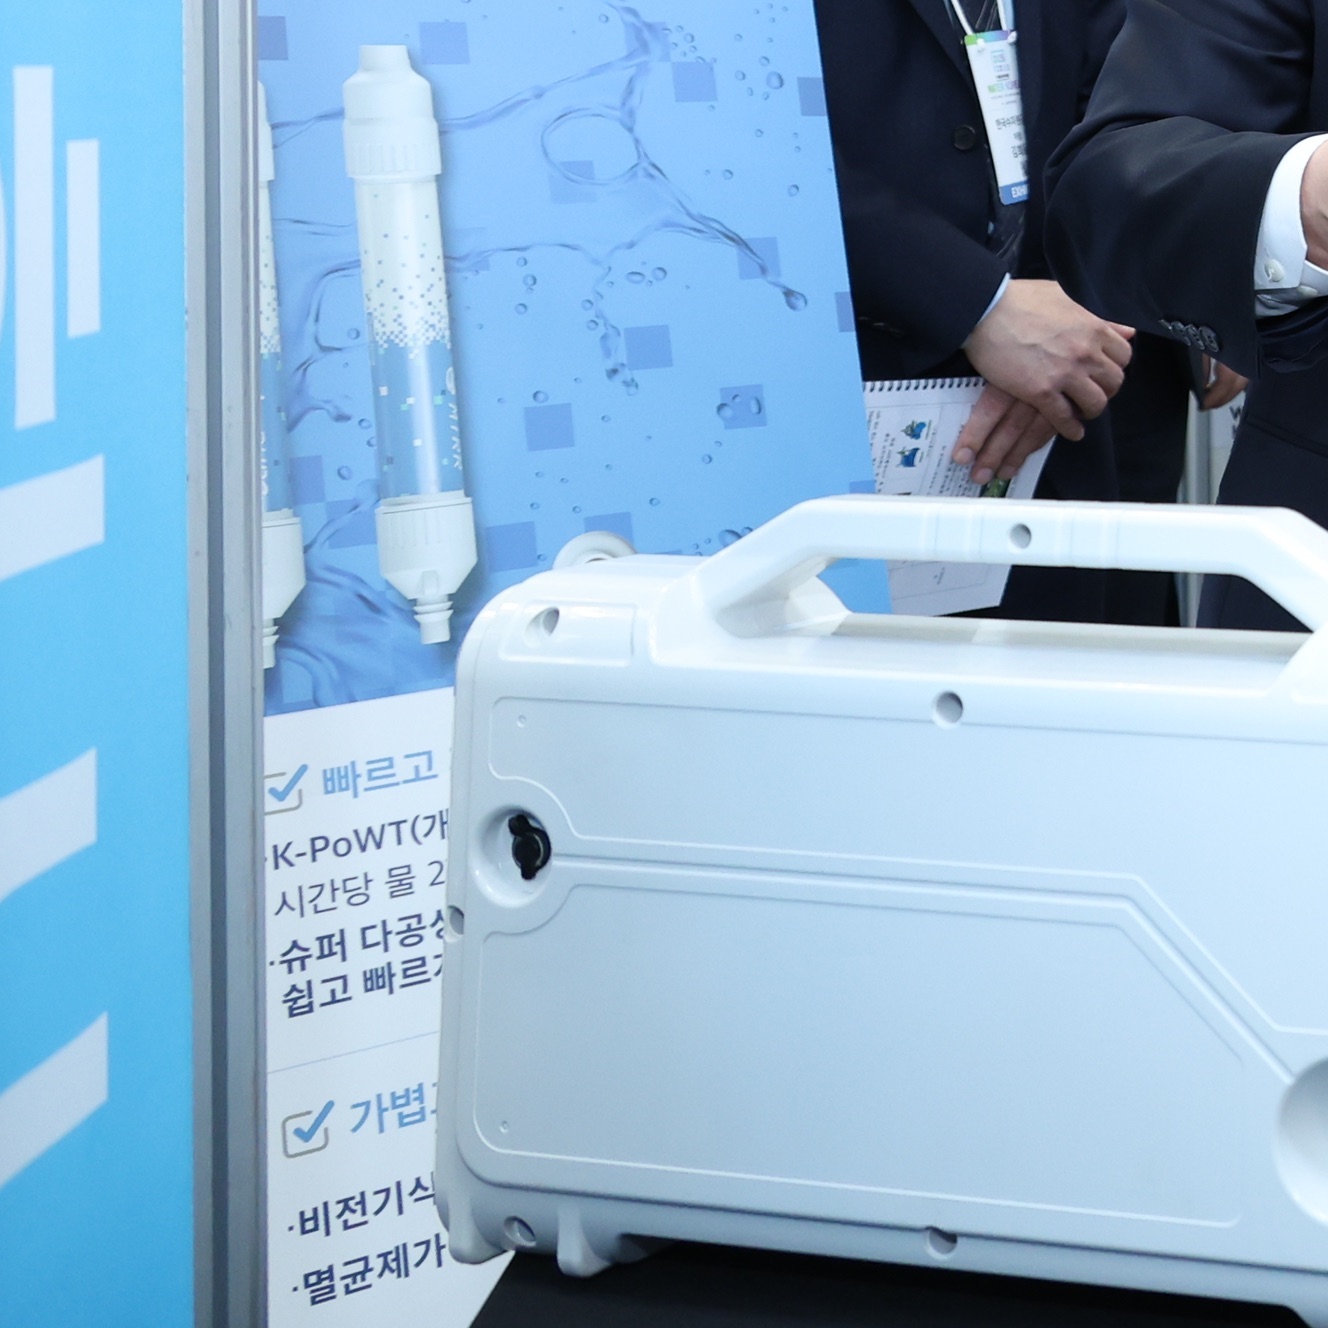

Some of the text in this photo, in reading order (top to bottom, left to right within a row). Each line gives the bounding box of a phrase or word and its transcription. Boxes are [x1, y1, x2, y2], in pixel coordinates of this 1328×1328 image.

[321, 749, 439, 800] 빠르고
[274, 871, 374, 919] 시간당
[384, 863, 417, 900] 물
[281, 974, 354, 1019] 쉽고
[350, 1081, 438, 1135] 가볍
